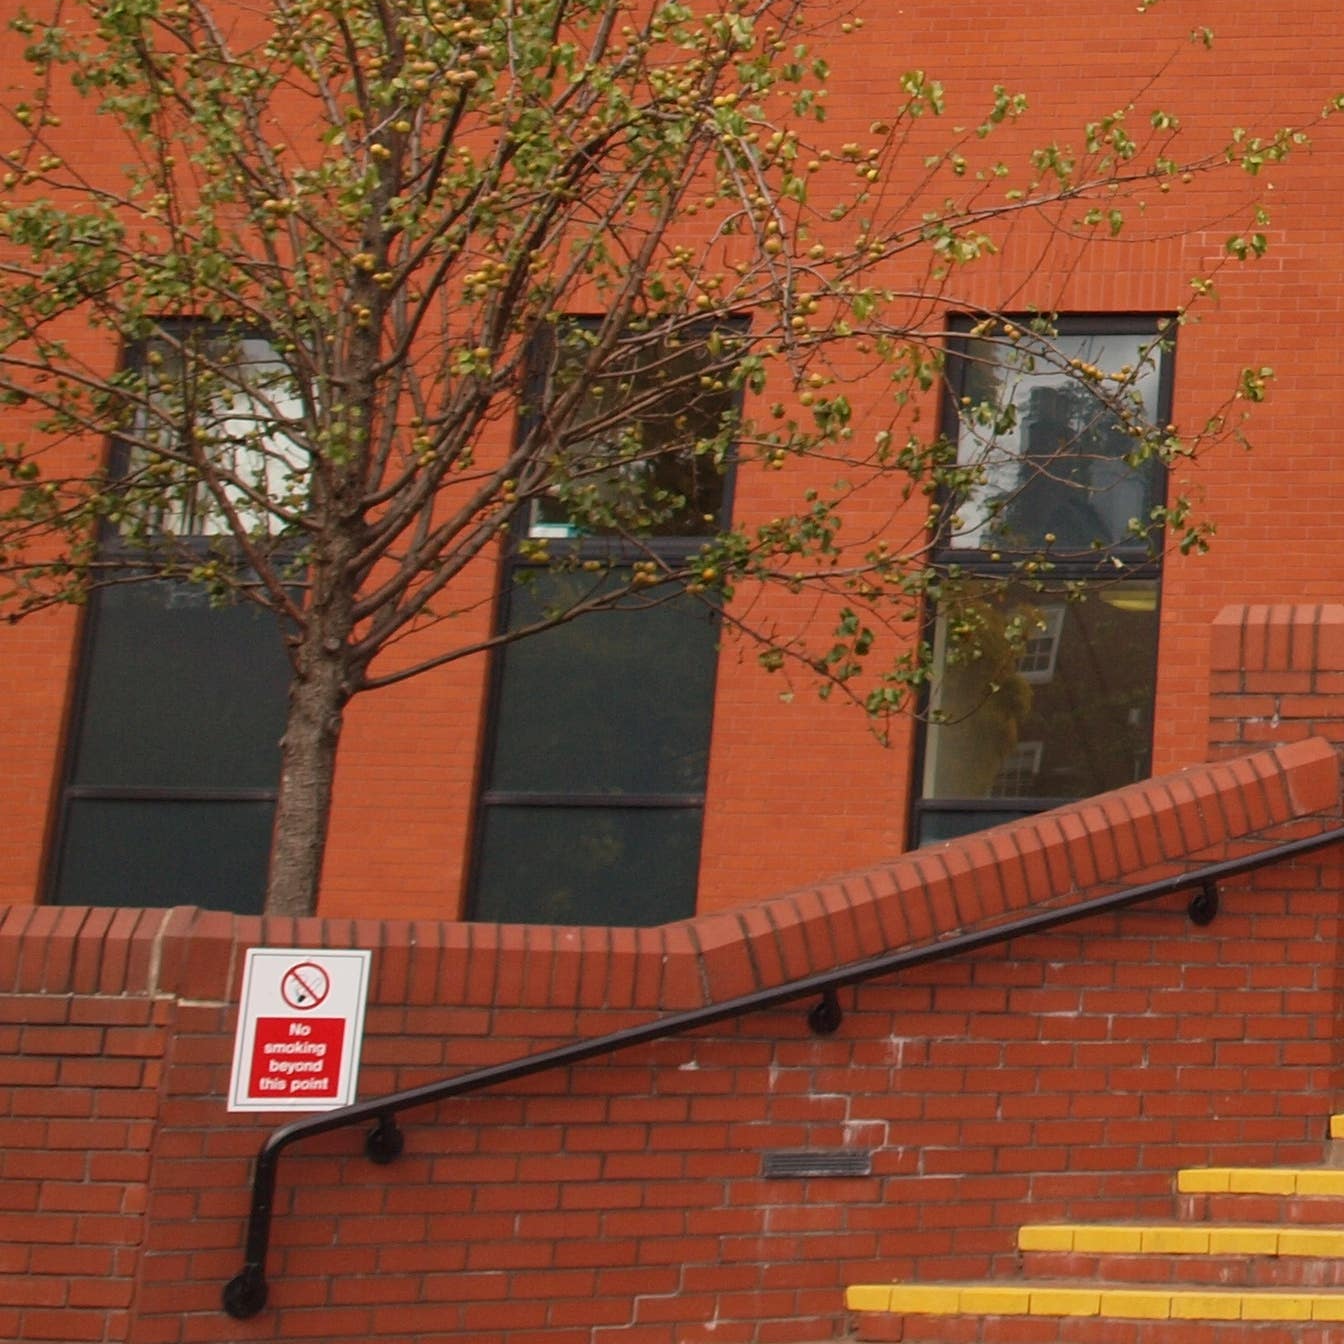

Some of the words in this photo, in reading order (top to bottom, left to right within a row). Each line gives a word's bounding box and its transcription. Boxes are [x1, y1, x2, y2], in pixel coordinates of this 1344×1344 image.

[289, 1023, 311, 1036] No
[264, 1042, 327, 1057] smoking
[269, 1059, 324, 1075] beyond
[259, 1077, 287, 1090] this
[290, 1077, 329, 1093] point
